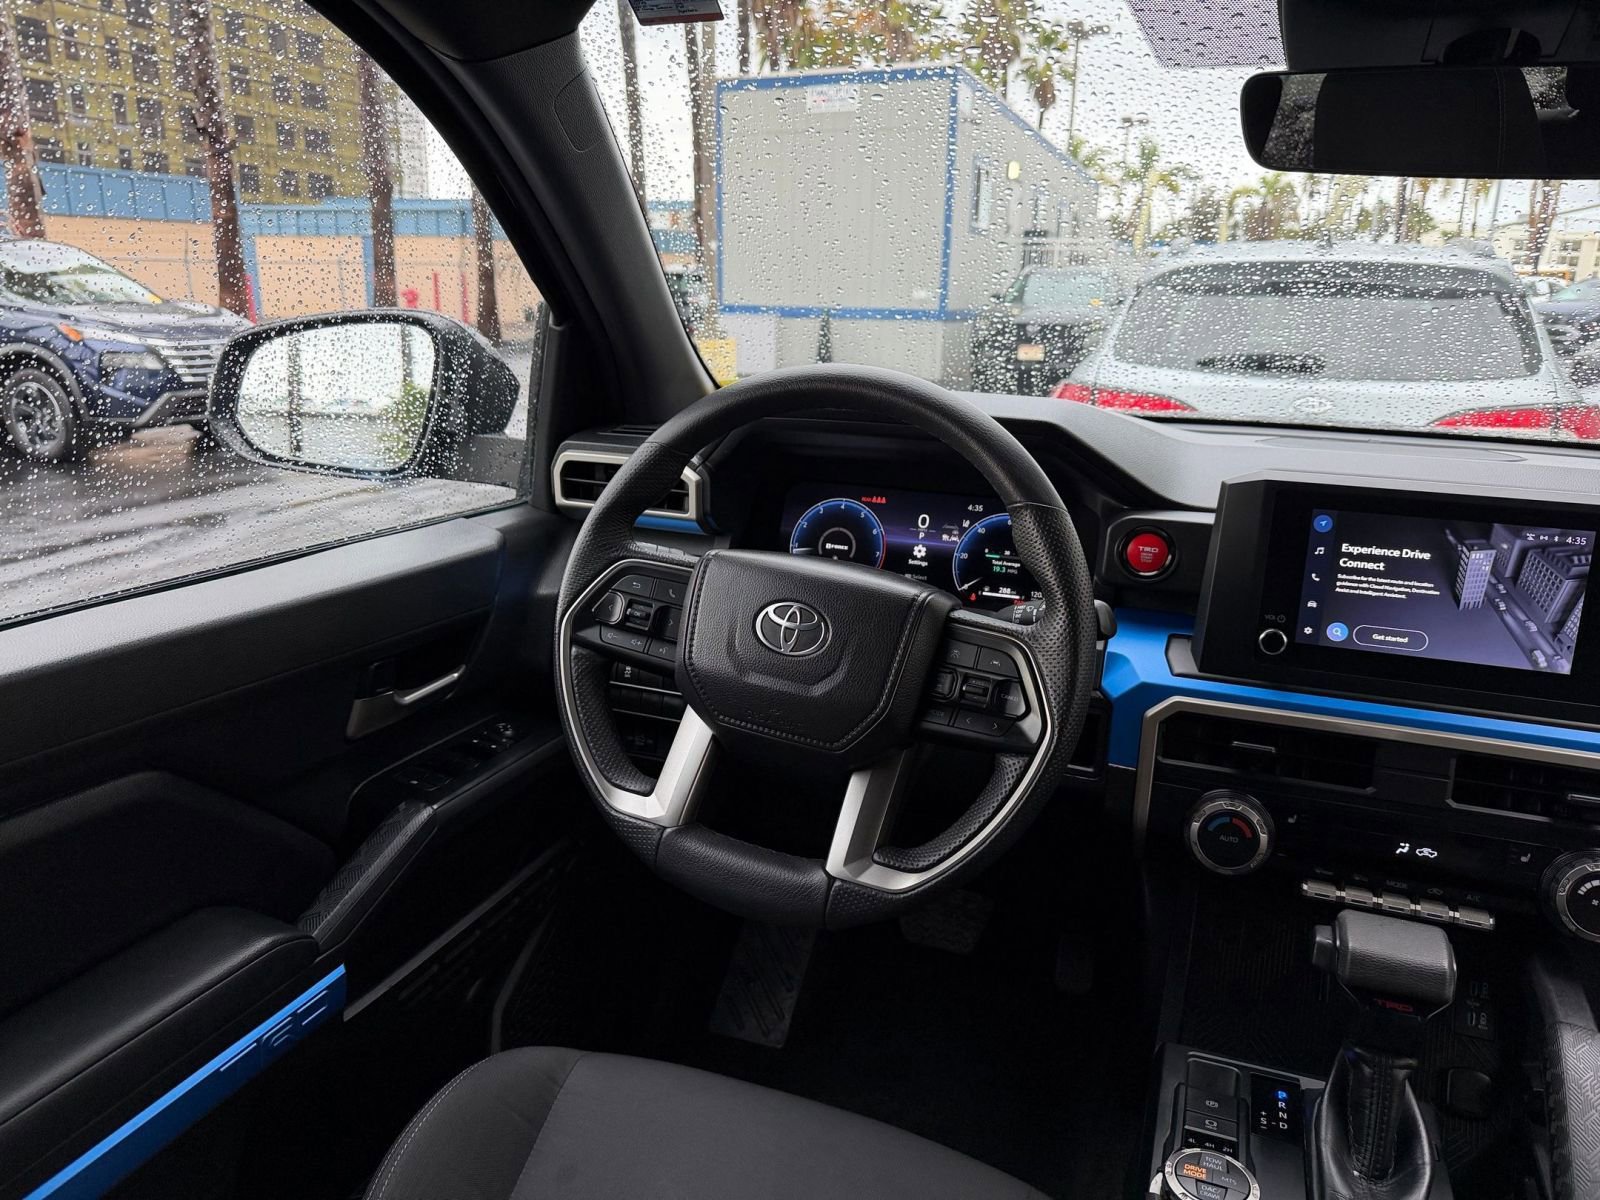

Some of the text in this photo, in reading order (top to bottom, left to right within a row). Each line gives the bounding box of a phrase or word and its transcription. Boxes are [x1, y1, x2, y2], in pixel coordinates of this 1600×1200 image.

[967, 504, 984, 512] 4:35
[917, 514, 930, 529] 0
[918, 532, 925, 540] P
[1565, 536, 1587, 545] 4:35
[1137, 545, 1159, 553] TRD
[1341, 543, 1432, 560] Experience Drive
[908, 558, 928, 567] Settings
[1339, 557, 1386, 571] Connect
[1372, 633, 1409, 643] Get started
[1219, 834, 1239, 844] AUTO
[1374, 998, 1414, 1012] TRD
[1278, 1090, 1288, 1099] P
[1278, 1101, 1287, 1110] R
[1279, 1111, 1288, 1120] N
[1260, 1117, 1267, 1125] S
[1279, 1121, 1288, 1130] D
[1205, 1156, 1223, 1165] TOW
[1184, 1163, 1207, 1174] DRIVE
[1203, 1161, 1224, 1171] HAUL
[1183, 1169, 1207, 1180] MODE
[1221, 1176, 1237, 1186] MTS
